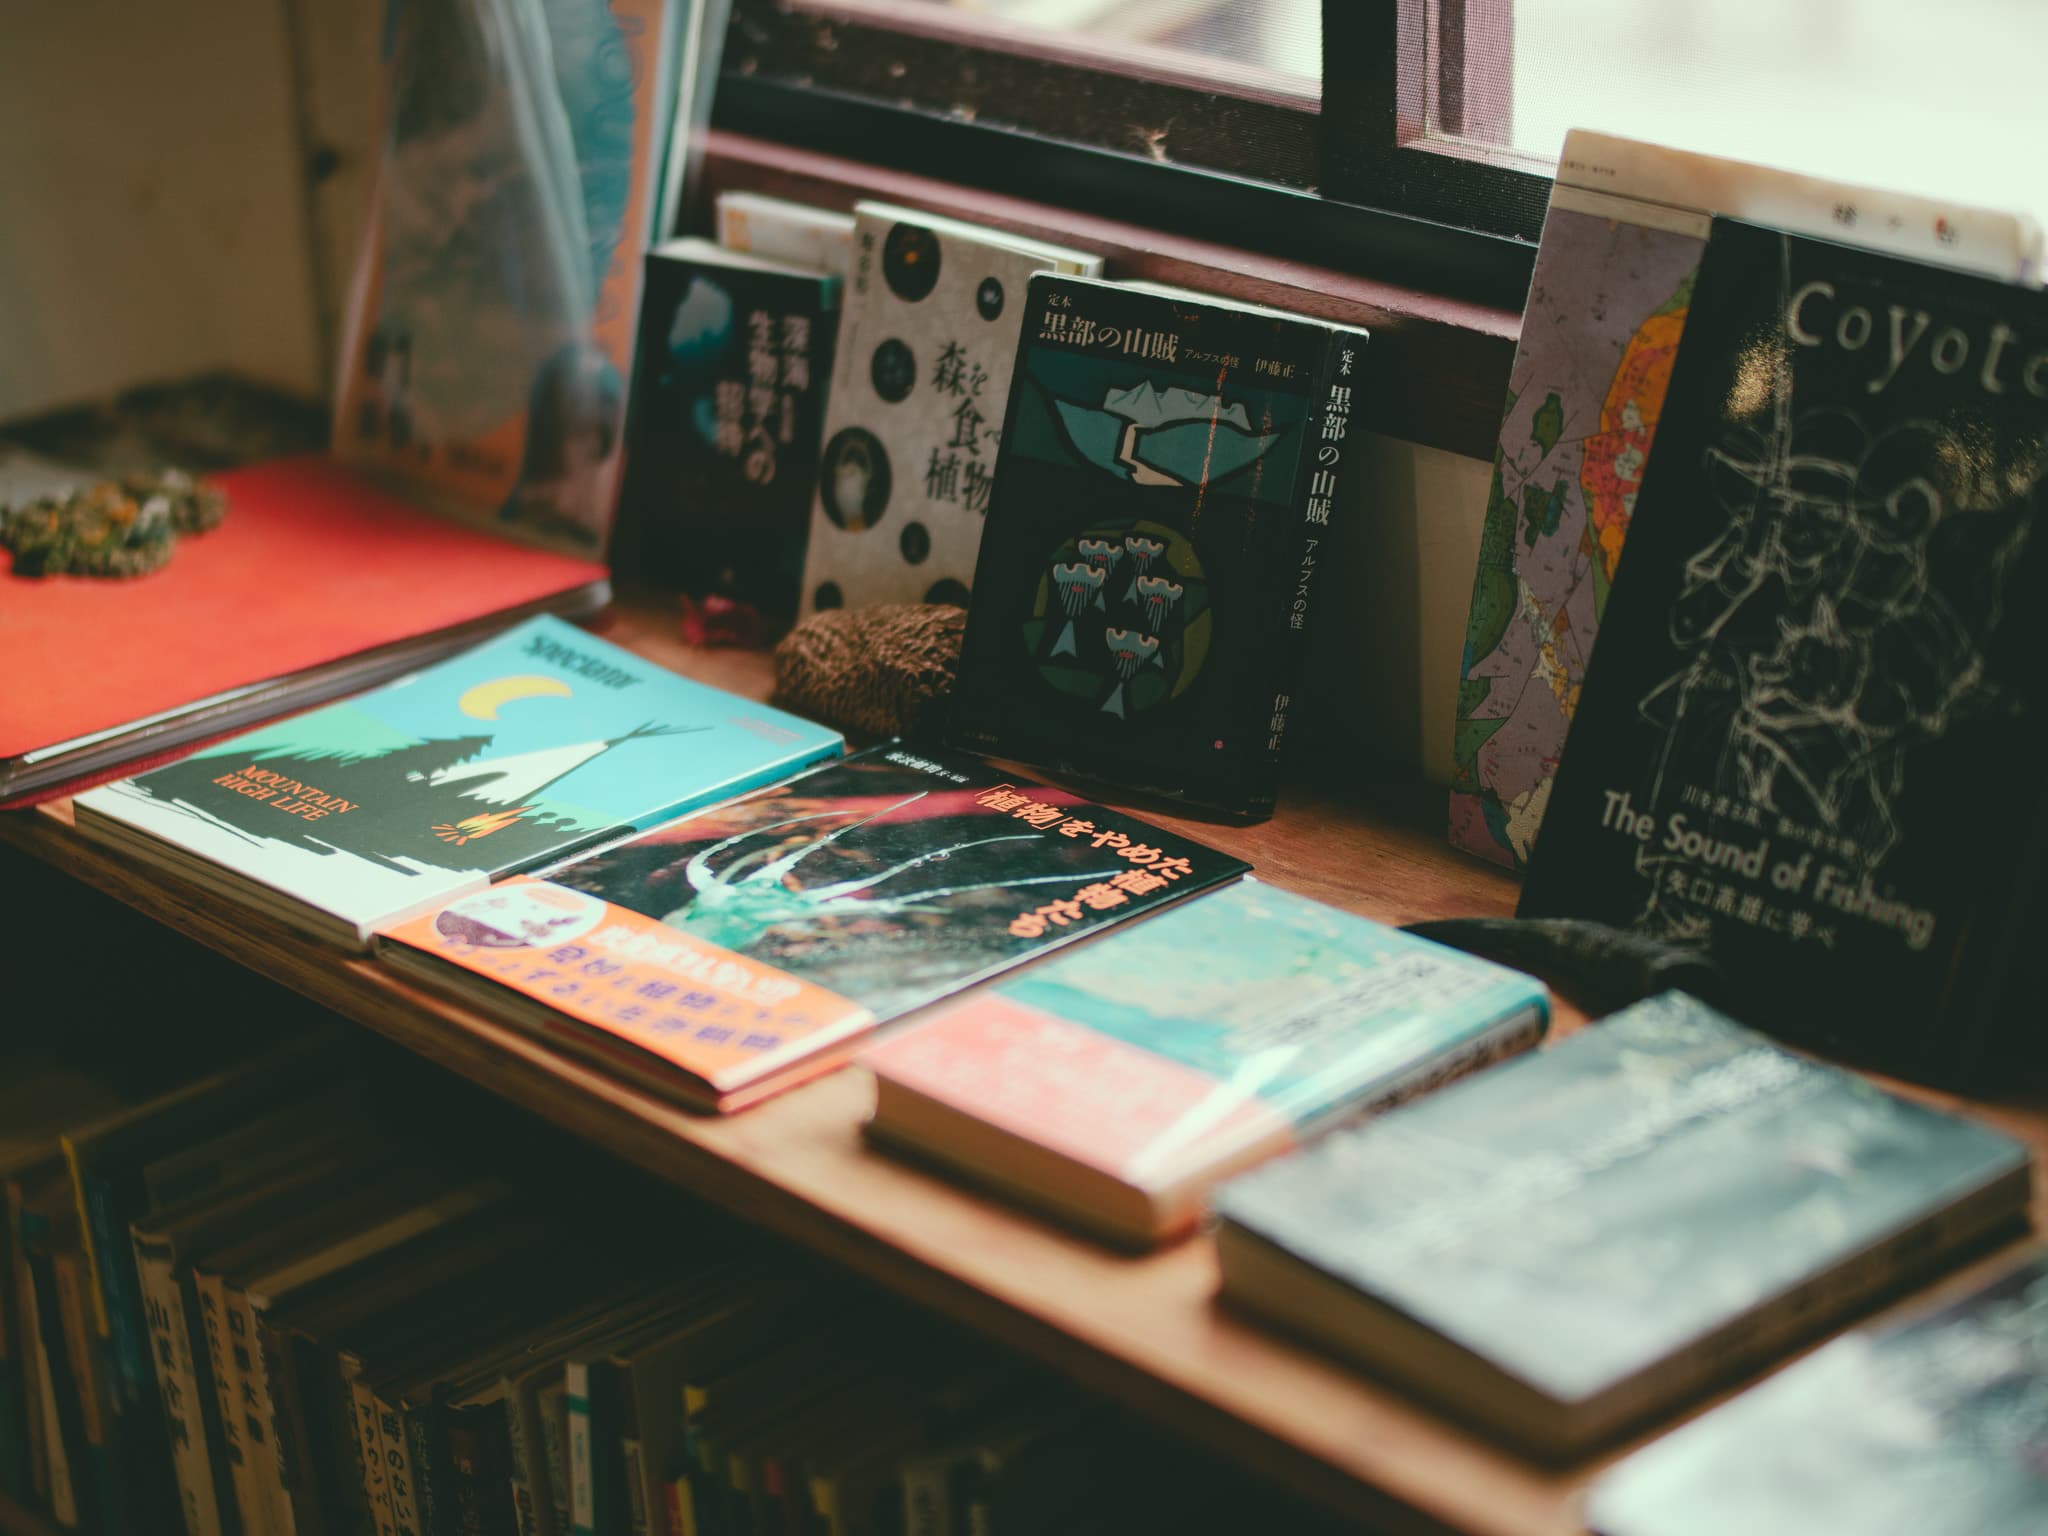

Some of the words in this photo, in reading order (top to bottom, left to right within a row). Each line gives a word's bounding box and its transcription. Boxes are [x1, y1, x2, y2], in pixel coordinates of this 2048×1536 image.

[1039, 311, 1179, 363] 黒部の山賊
[1305, 385, 1351, 525] 黒部の山賊
[212, 773, 278, 800] HIGH
[269, 796, 329, 821] LIFE
[236, 764, 360, 813] MOUNTAIN
[1602, 789, 1656, 841] The
[1663, 812, 1769, 879] Sound
[1771, 853, 1813, 892] of
